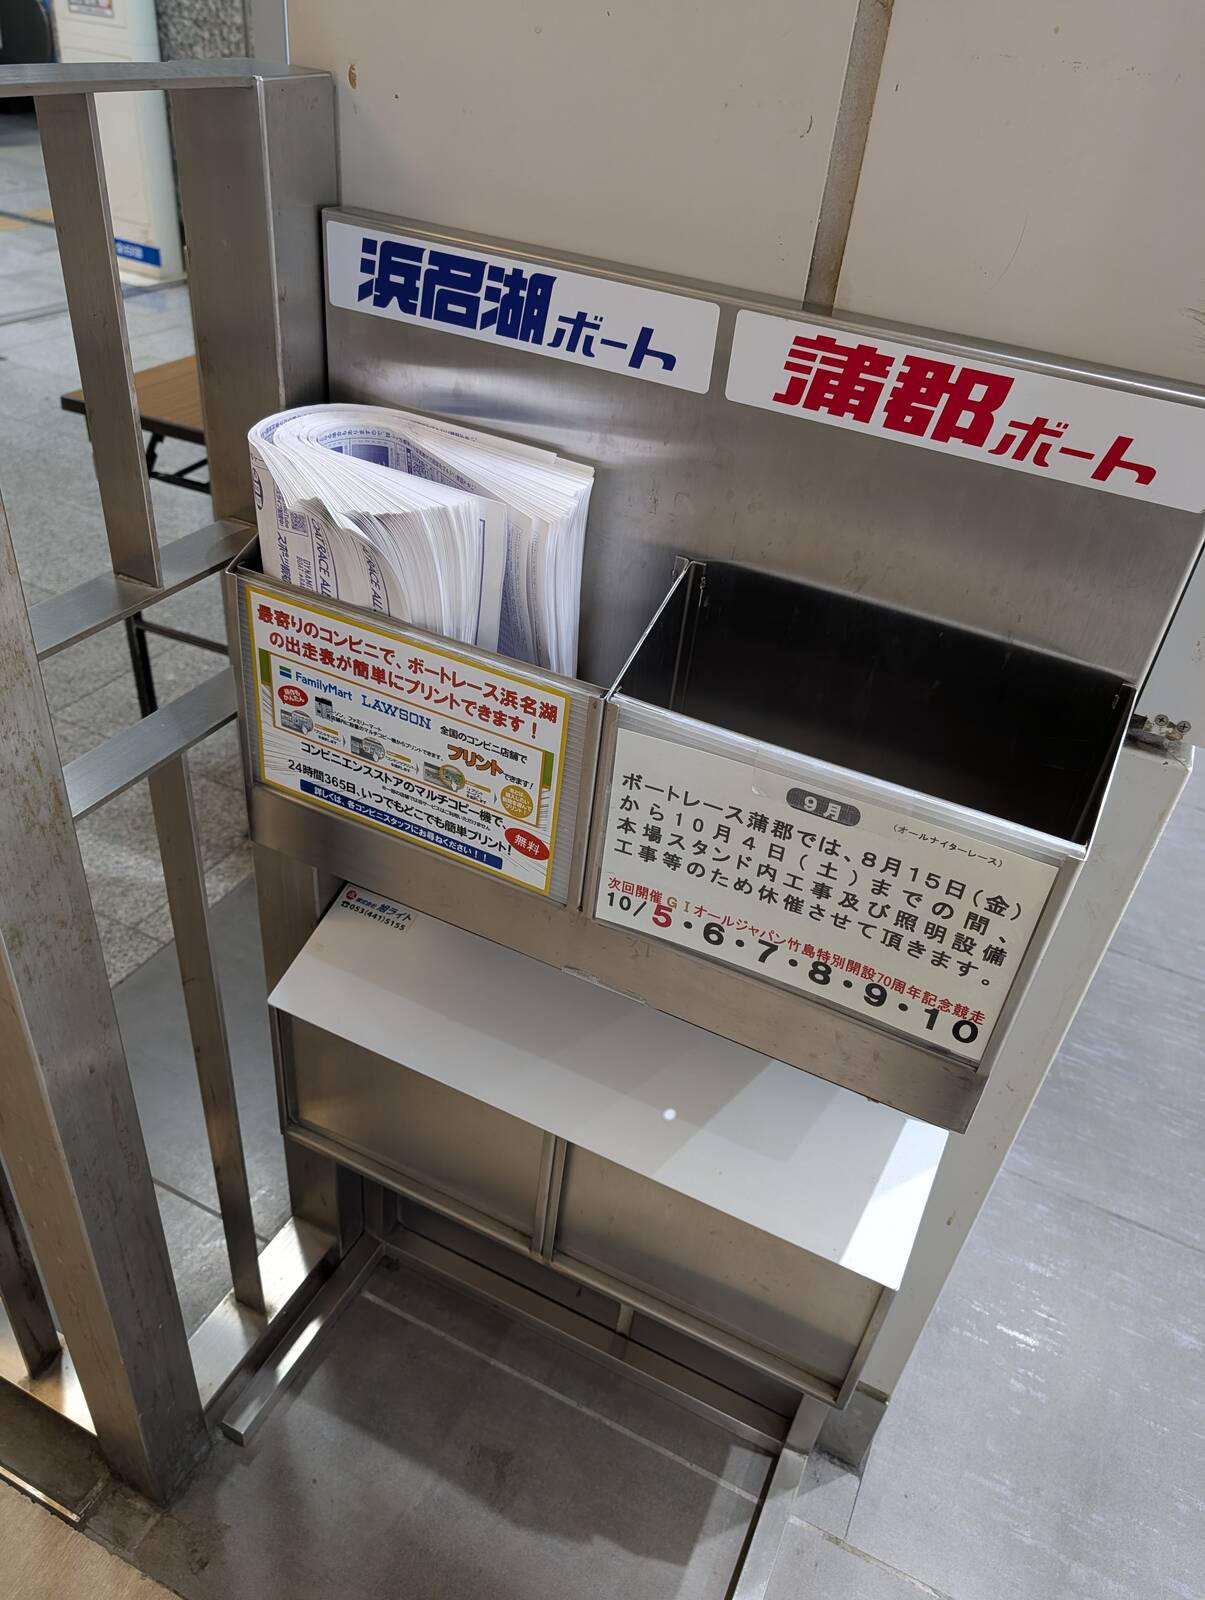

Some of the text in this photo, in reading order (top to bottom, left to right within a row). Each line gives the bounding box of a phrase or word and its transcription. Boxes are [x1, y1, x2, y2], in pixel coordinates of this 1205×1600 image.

[773, 335, 1158, 487] 蒲郡ボート
[257, 604, 558, 723] 最寄りのコンビニで、ボートレース浜名湖
[269, 633, 538, 739] の出走表が簡単にプリントできます！
[296, 672, 352, 701] FamilyMart
[361, 694, 432, 729] LAWSON
[301, 742, 507, 830] コンビニエンスストアのマルチコピー機で、
[440, 725, 527, 764] 全国のコンビニ店舗で
[514, 834, 540, 856] 無料
[803, 795, 841, 820] 9月
[614, 843, 990, 986] 工事等のため休催させて頂きます。
[617, 817, 1008, 966] 本場スタンド内工事及び照明設備
